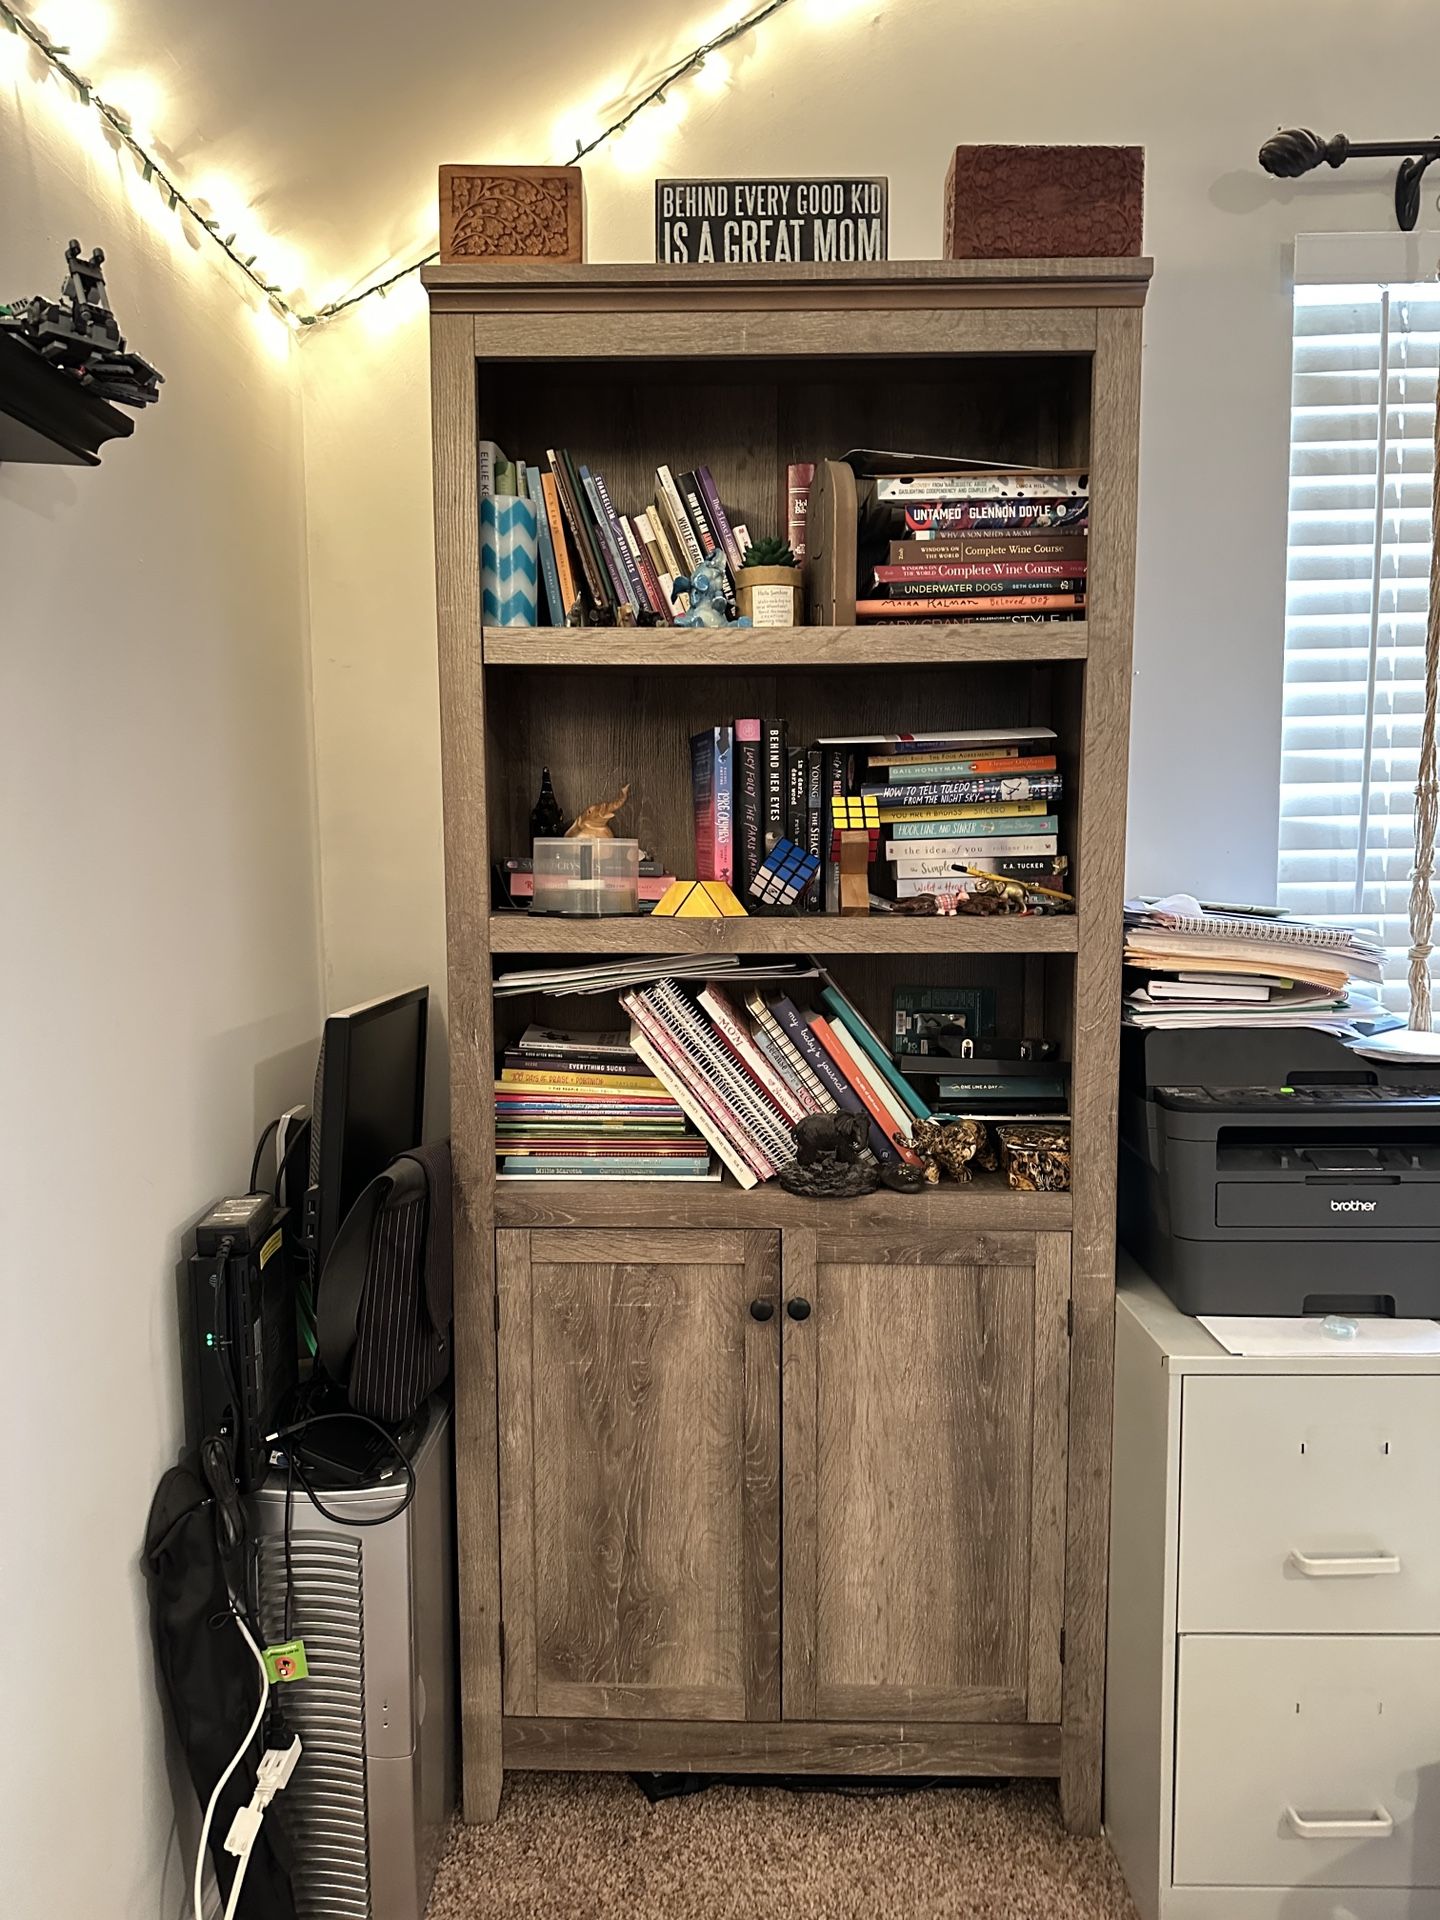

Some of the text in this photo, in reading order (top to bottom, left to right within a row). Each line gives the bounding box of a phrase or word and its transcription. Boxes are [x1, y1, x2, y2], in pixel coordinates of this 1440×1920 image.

[663, 184, 881, 217] BEHIND EVERY GOOD KID
[664, 219, 881, 263] IS A GREAT MOM
[480, 451, 489, 482] ELLIE
[686, 491, 709, 534] HOW TO BE AN
[710, 497, 731, 534] The 5 Love
[914, 506, 962, 521] UNTAMED
[969, 505, 1016, 519] GLENNON
[1018, 504, 1051, 518] DOYLE
[676, 515, 694, 543] WHITE
[940, 531, 957, 539] WHY
[967, 531, 982, 539] SON
[614, 534, 637, 573] ADDITIVES
[964, 545, 1006, 557] Complete
[1009, 545, 1031, 554] Wine
[1033, 544, 1065, 553] Course
[938, 564, 991, 579] Complete
[993, 563, 1023, 575] Wine
[1024, 562, 1064, 574] Course
[904, 584, 972, 594] UNDERWATER
[975, 583, 1004, 592] DOGS
[881, 596, 1050, 608] MAIRA KALMAN Beloved Dog
[958, 751, 995, 759] AGREEMENTS
[797, 760, 804, 769] in
[914, 765, 964, 774] HONEYMAN
[769, 729, 780, 821] BEHIND HER EYES
[811, 764, 820, 798] YOUNG
[883, 783, 971, 798] HOW TO TELL TOLEDO
[743, 746, 758, 852] LUCY FOLEY THE PARIS
[903, 792, 980, 805] FROM THE NIGHT SKY
[934, 809, 963, 817] BADASS
[973, 806, 1006, 815] SINCERO
[951, 822, 977, 834] SINKER
[904, 846, 920, 855] the
[925, 845, 949, 854] idea
[952, 844, 961, 854] of
[965, 846, 984, 855] you
[921, 862, 952, 876] Simple
[1017, 861, 1044, 870] TUCKER
[913, 882, 935, 892] Wild
[944, 881, 968, 892] Heart
[718, 1016, 743, 1048] MOM
[764, 1041, 790, 1071] because
[782, 1010, 801, 1029] my
[795, 1027, 824, 1060] baby's
[816, 1058, 848, 1095] journal
[568, 1063, 626, 1072] EVERYTHING SUCKS
[1331, 1200, 1377, 1212] brother
